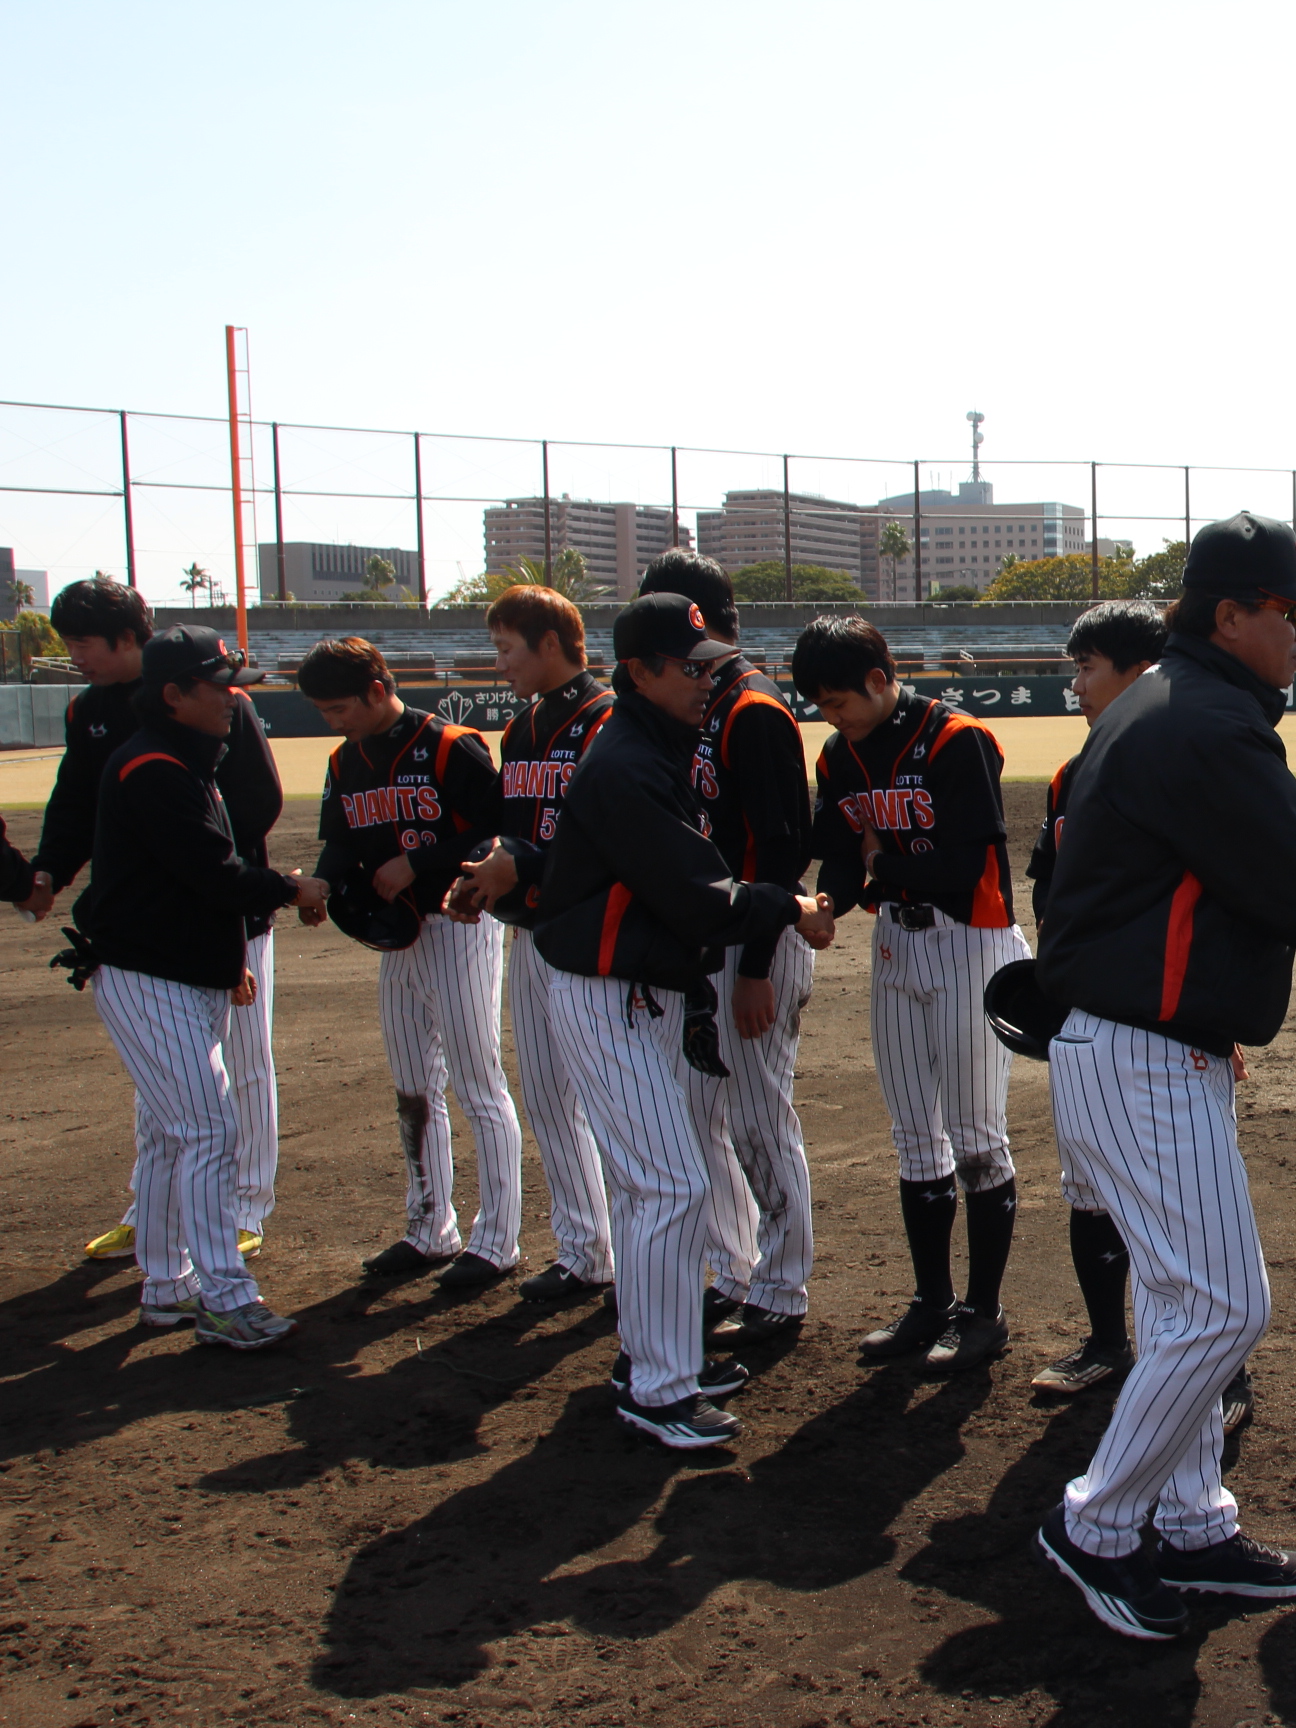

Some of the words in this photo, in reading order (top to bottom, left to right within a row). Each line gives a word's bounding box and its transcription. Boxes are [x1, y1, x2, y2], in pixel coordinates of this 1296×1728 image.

[941, 686, 1032, 706] さつま
[551, 750, 576, 760] LOTTE
[397, 774, 430, 784] LOTTE
[895, 775, 923, 785] LOTTE
[341, 785, 442, 829] GIANTS
[838, 788, 936, 834] GANTS
[540, 808, 561, 840] 5
